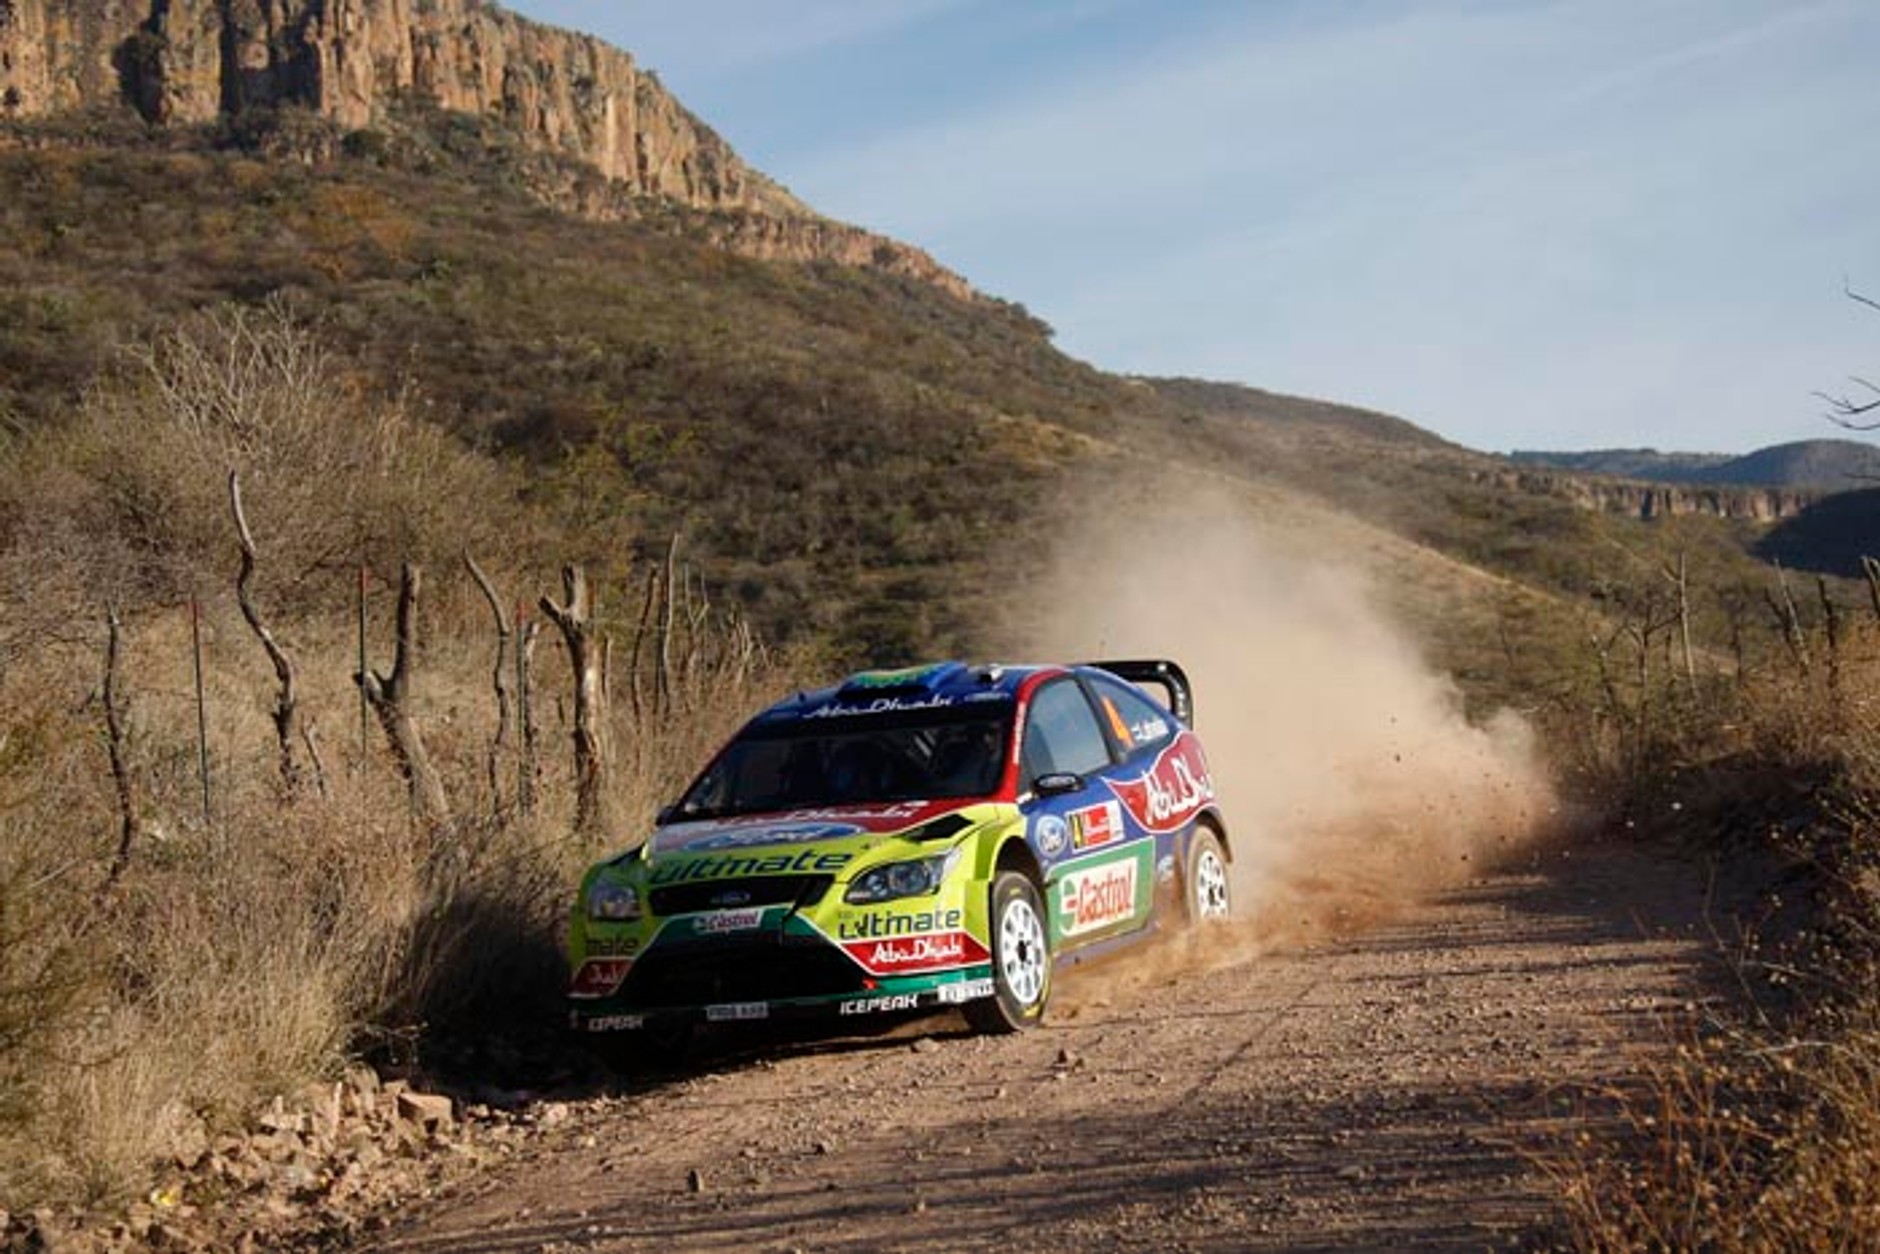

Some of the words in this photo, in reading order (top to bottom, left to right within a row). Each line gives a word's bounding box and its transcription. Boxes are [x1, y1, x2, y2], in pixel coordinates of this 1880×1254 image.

[862, 693, 956, 713] Dhabi
[1079, 864, 1132, 924] Castrol
[709, 910, 759, 931] Castrol
[870, 942, 907, 964] Abu
[905, 935, 964, 960] Dhabi
[840, 994, 919, 1016] ICEPEAK
